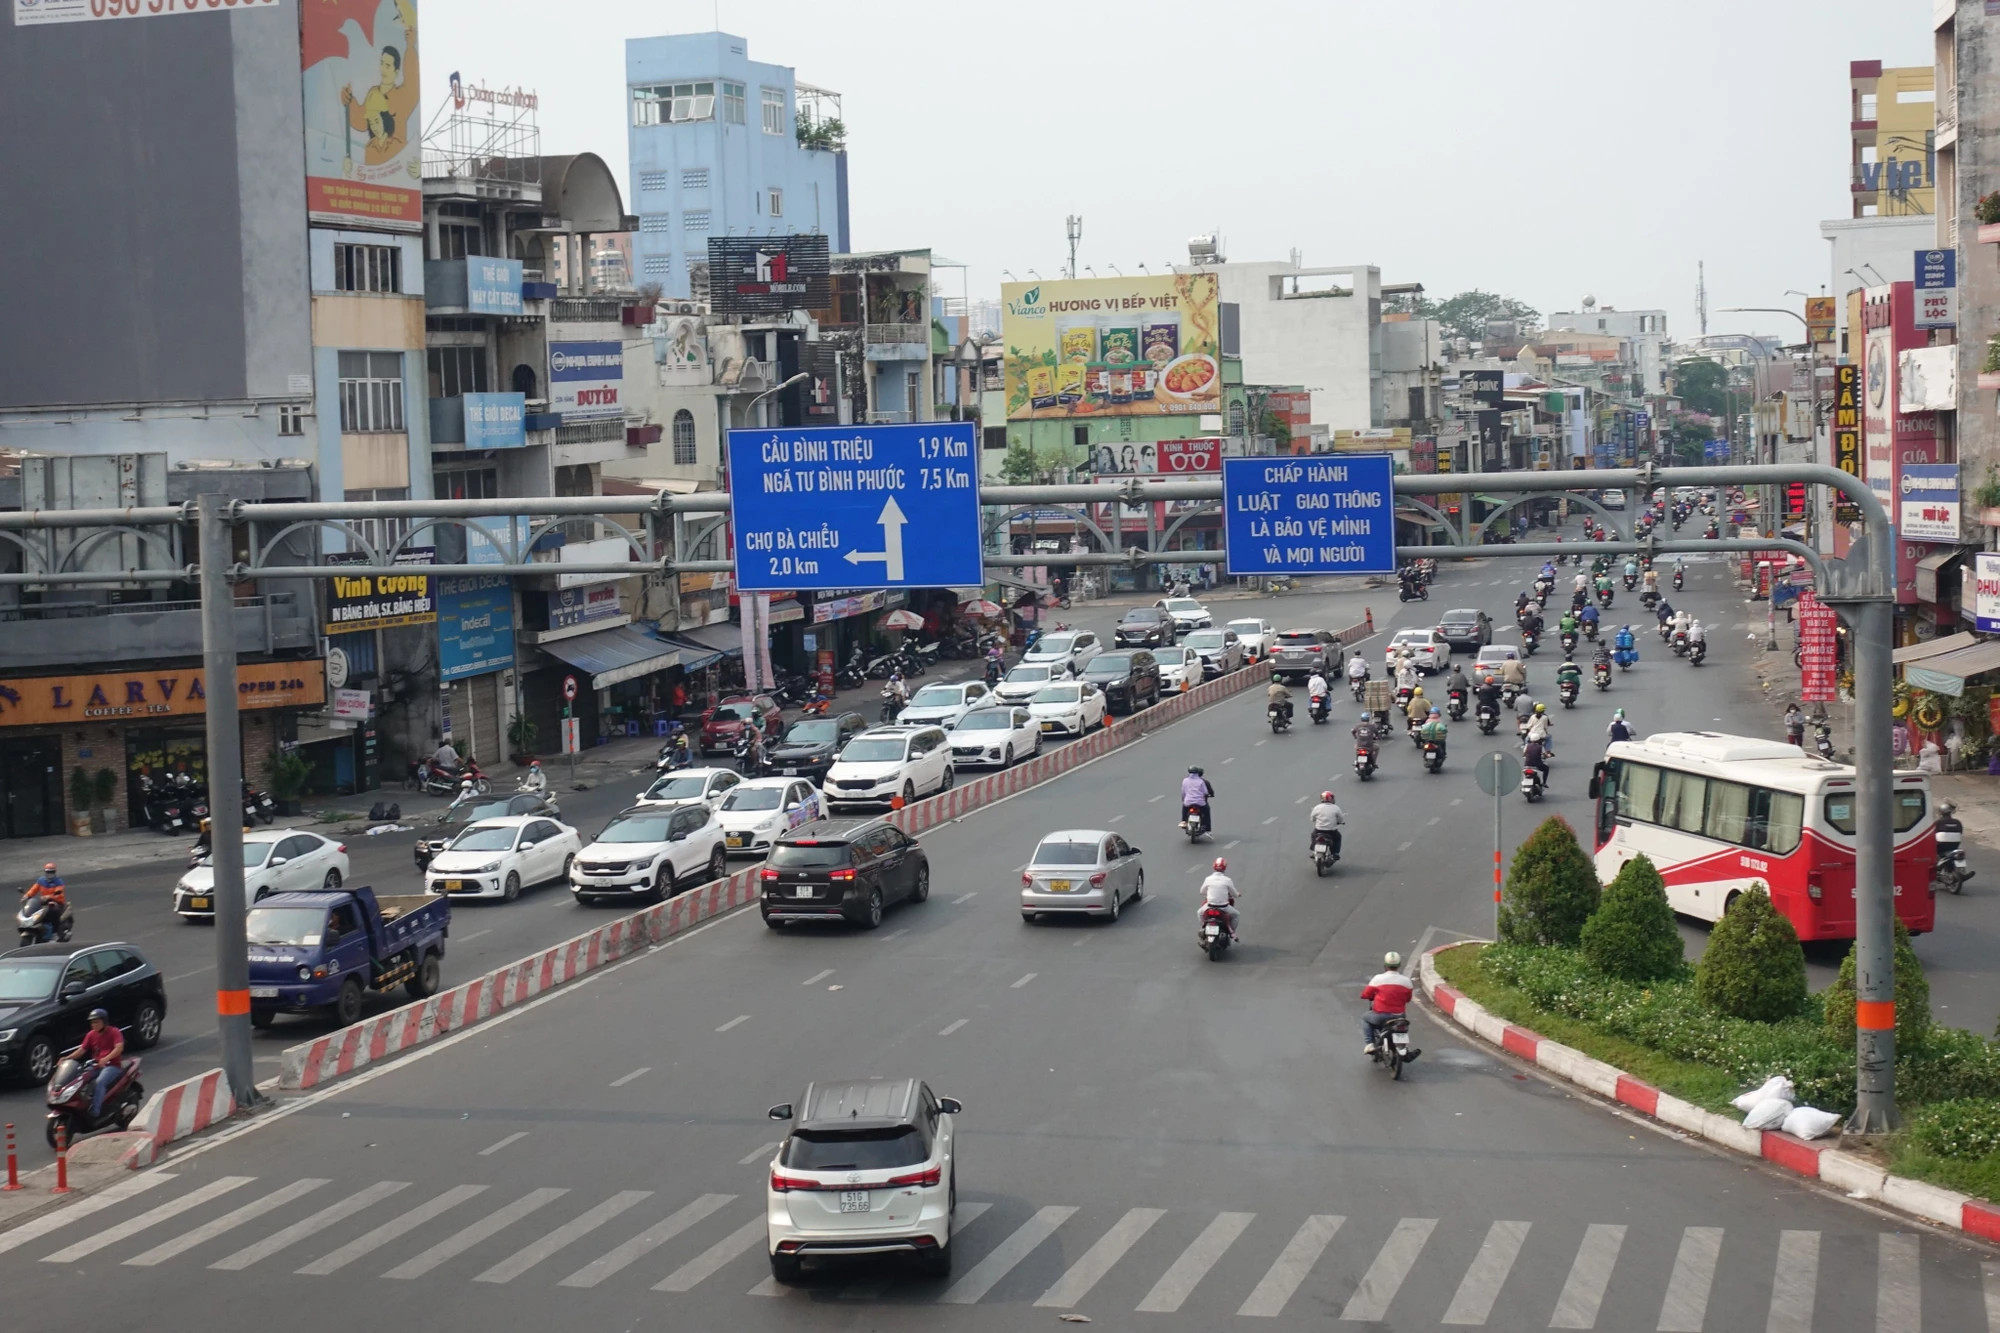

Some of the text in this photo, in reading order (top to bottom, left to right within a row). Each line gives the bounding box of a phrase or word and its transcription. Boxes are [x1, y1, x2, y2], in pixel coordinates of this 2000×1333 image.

[1008, 298, 1046, 315] Vianco
[1049, 292, 1178, 312] HƯƠNG VỊ BẾP VIỆT
[1924, 296, 1948, 306] PHÚ
[1925, 308, 1947, 319] LỘC
[499, 405, 522, 421] DECAL
[762, 435, 968, 464] CẦU BÌNH TRIỆU 1,9 Km
[1163, 439, 1214, 452] KÍNH THUỐC
[763, 463, 970, 493] NGÃ TƯ BÌNH PHƯỚC 7,5 Km
[1264, 462, 1348, 483] CHẤP HÀNH
[1237, 492, 1280, 514] LUẬT
[1296, 493, 1329, 510] GIAO
[1332, 489, 1381, 509] THÔNG
[1250, 513, 1371, 538] LÀ BẢO VỆ MÌNH
[746, 523, 839, 552] CHỢ BÀ CHIỂU
[1263, 542, 1365, 566] VÀ MỌI NGƯỜI
[769, 557, 819, 576] 2,0 km
[479, 574, 509, 589] DECAL
[332, 608, 341, 622] IN
[342, 604, 363, 620] BĂNG
[52, 678, 304, 709] LARVA OPEN 24h
[85, 706, 133, 717] COFFEE
[147, 704, 171, 713] TEA
[847, 1192, 863, 1202] 51G
[841, 1202, 869, 1211] 735.66
